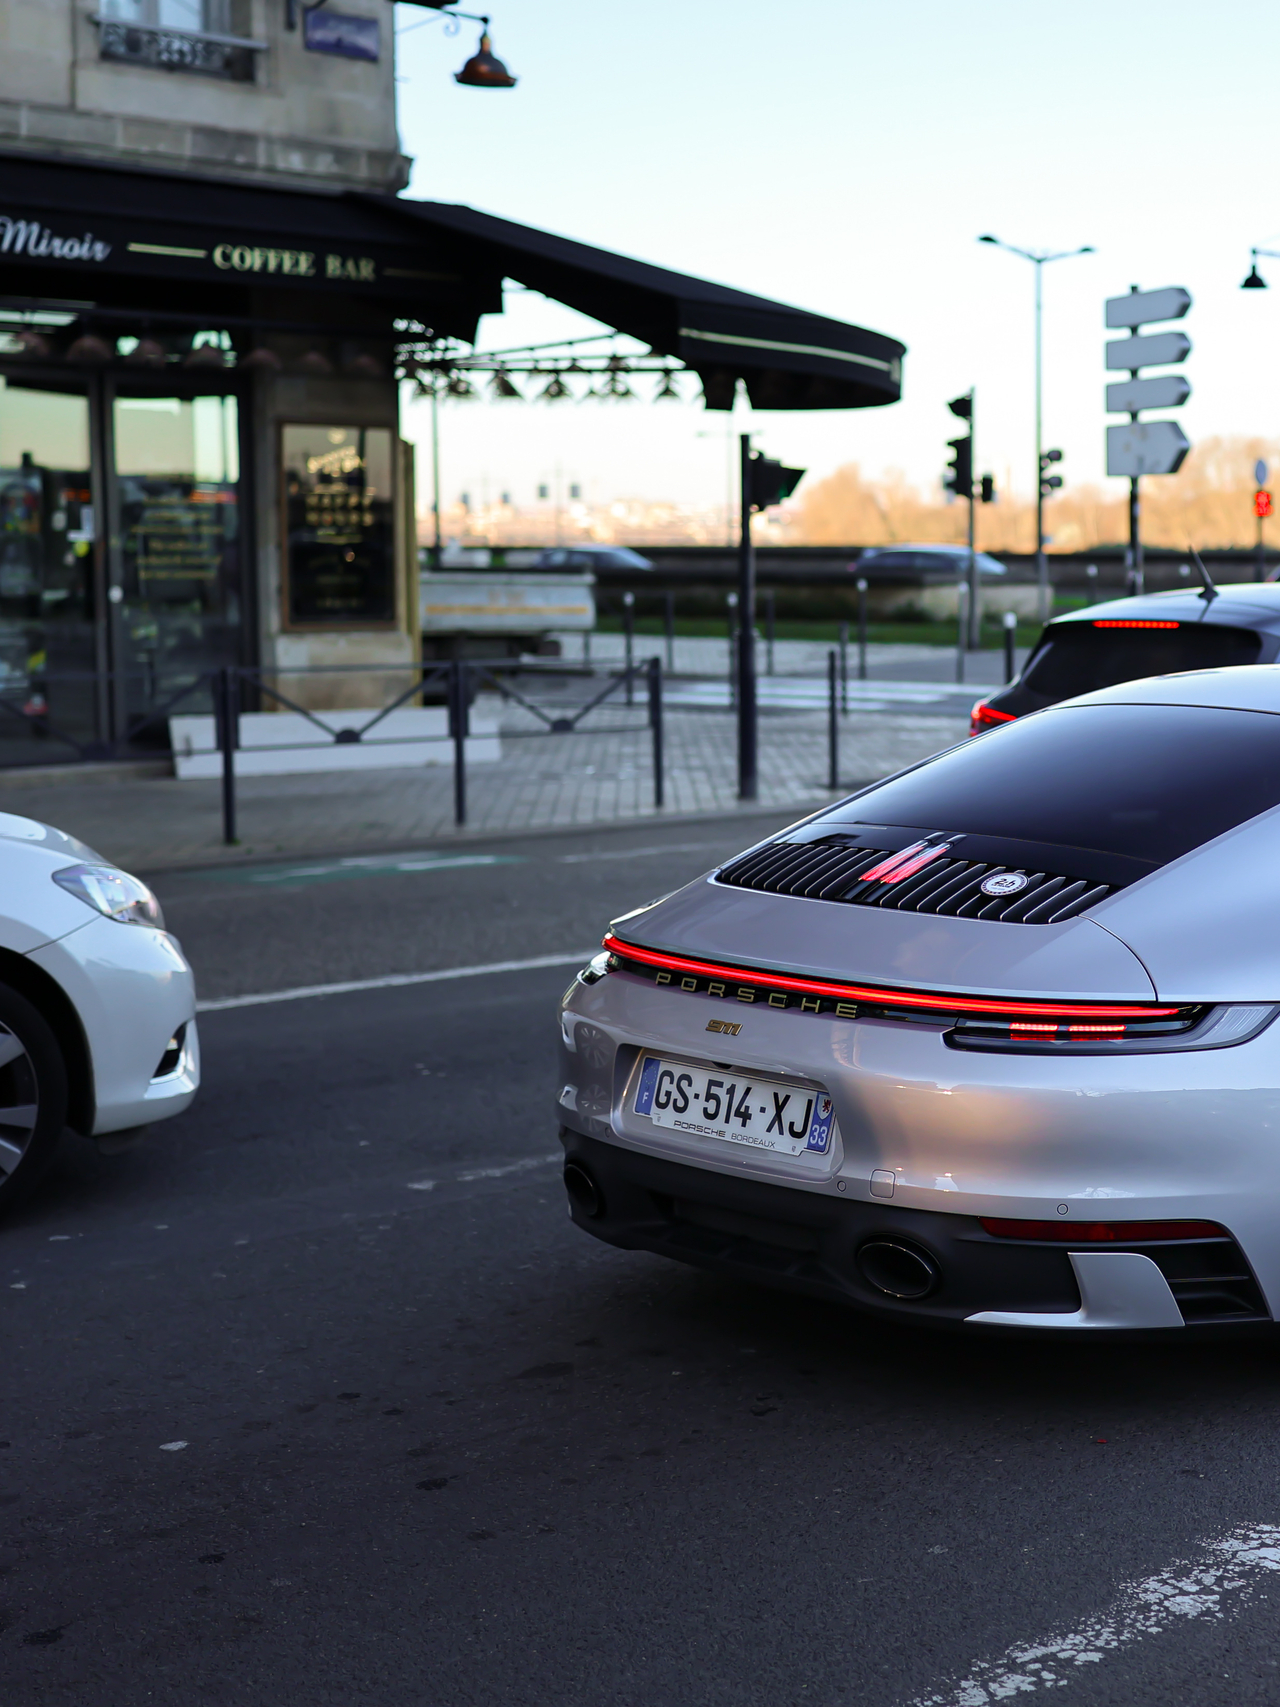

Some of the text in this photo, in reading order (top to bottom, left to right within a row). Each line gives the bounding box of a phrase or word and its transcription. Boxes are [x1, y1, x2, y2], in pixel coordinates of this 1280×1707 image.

[0, 215, 112, 262] Miroir
[213, 243, 376, 282] COFFEE BAR
[655, 971, 858, 1018] PORSCHE
[705, 1019, 743, 1036] 911
[642, 1091, 650, 1104] F
[809, 1124, 828, 1146] 33
[673, 1119, 776, 1149] PORSCHE BORDEAUX
